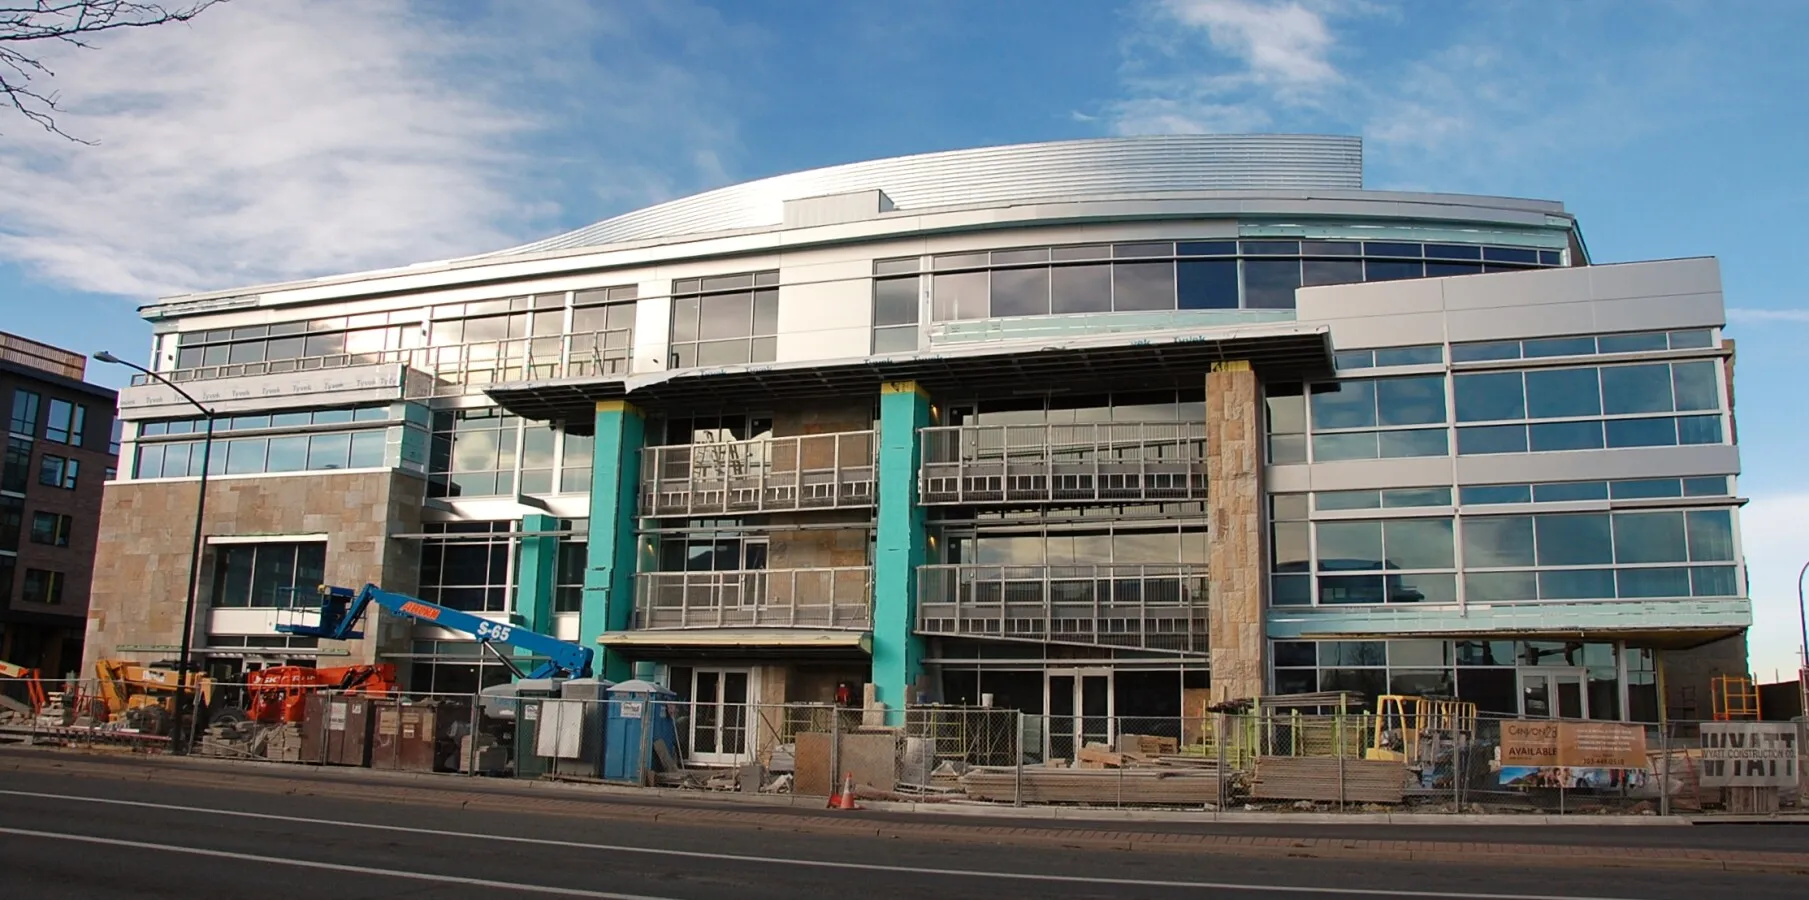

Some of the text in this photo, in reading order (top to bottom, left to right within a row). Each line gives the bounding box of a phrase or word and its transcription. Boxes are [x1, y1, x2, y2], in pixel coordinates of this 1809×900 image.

[477, 621, 511, 641] S-65
[1509, 747, 1558, 757] AVAILABLE
[1702, 749, 1725, 759] WYATT
[1728, 749, 1783, 759] CONSTRUCTION
